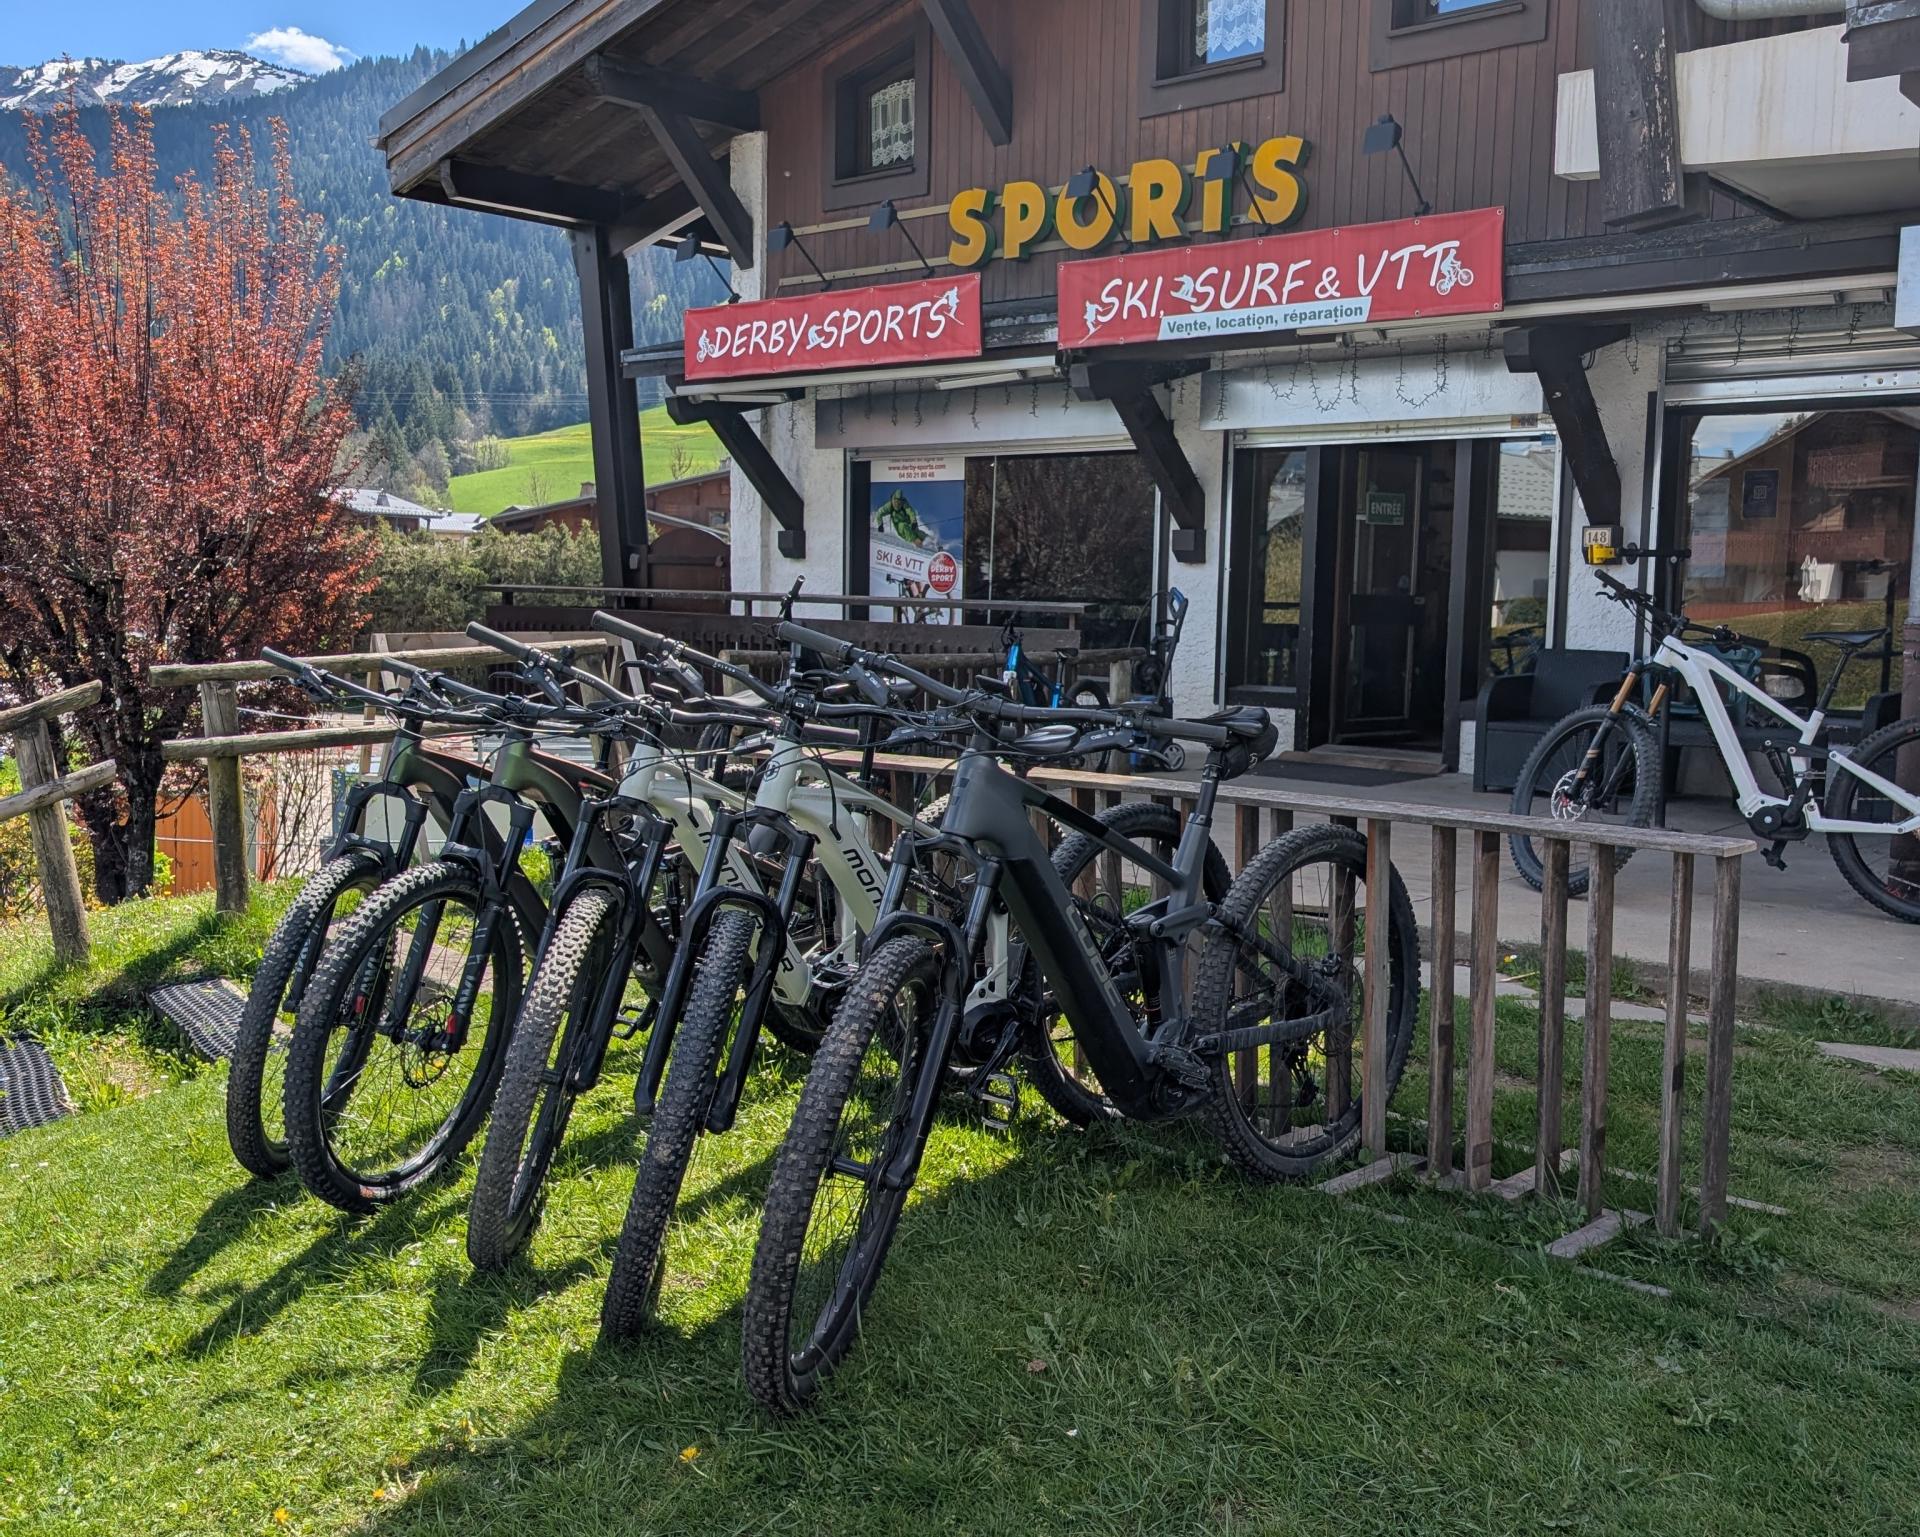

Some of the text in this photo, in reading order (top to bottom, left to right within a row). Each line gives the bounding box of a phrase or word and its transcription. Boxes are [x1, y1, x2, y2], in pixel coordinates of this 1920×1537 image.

[947, 135, 1307, 268] SPORTS
[1098, 240, 1460, 324] SKI, SURF & VTT
[715, 299, 948, 357] DERBY SPORTS
[1167, 304, 1363, 336] Vente, location, réparation
[1588, 531, 1607, 543] 148
[876, 549, 893, 563] SKI
[895, 555, 902, 566] &
[905, 557, 925, 571] VTT
[930, 574, 954, 582] SPORT
